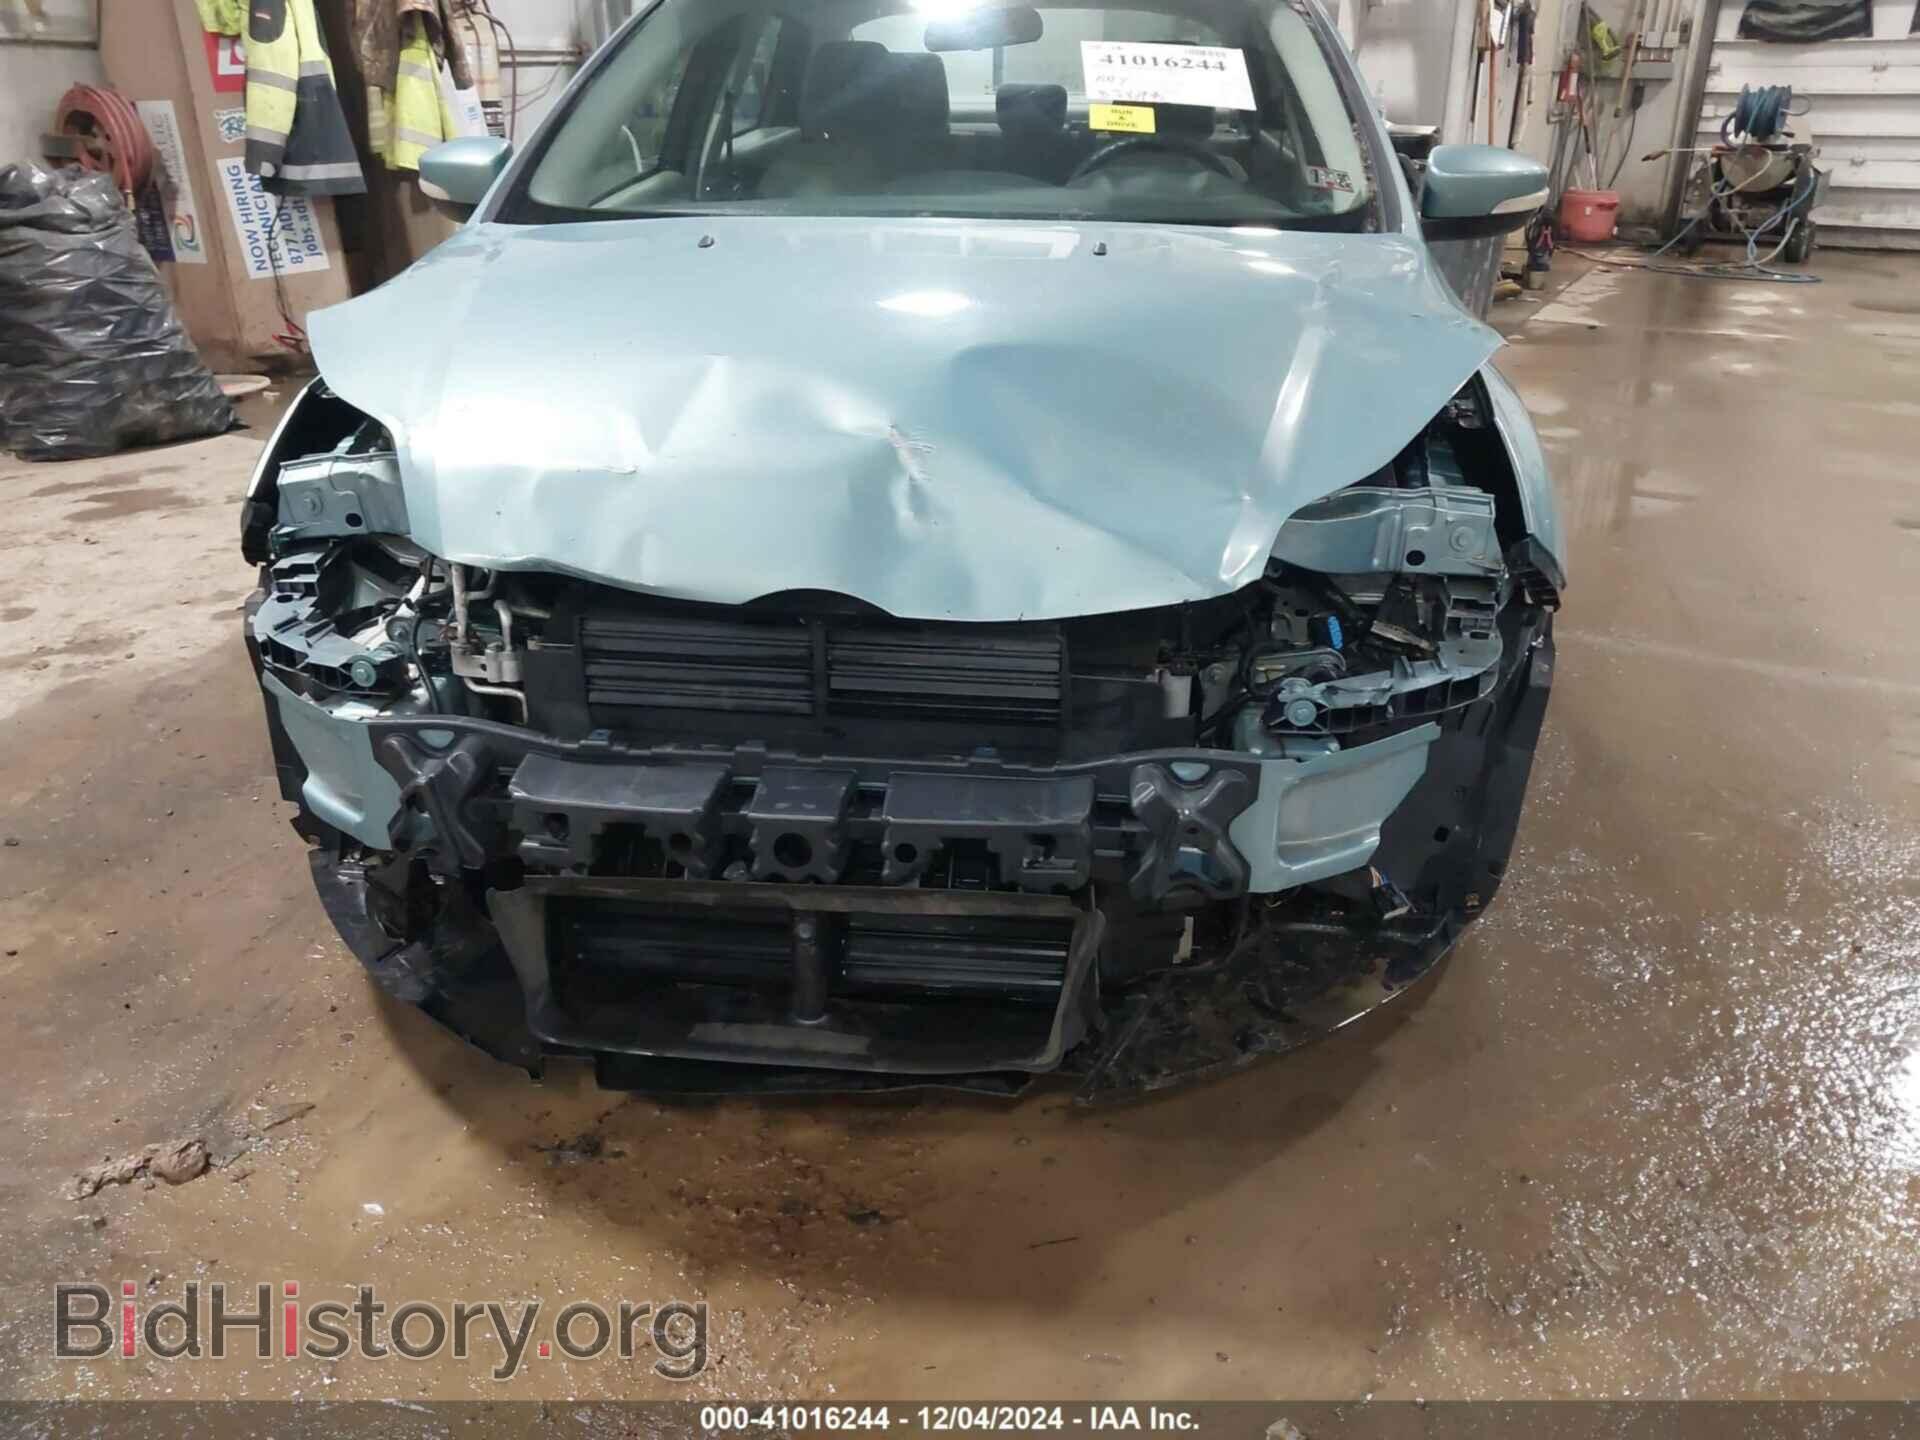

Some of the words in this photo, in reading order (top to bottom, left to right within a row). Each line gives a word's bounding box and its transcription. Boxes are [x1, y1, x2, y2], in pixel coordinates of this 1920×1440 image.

[1099, 53, 1227, 72] 41016244
[1110, 107, 1133, 115] RUN
[227, 164, 254, 224] HIRING
[244, 229, 269, 271] NOW
